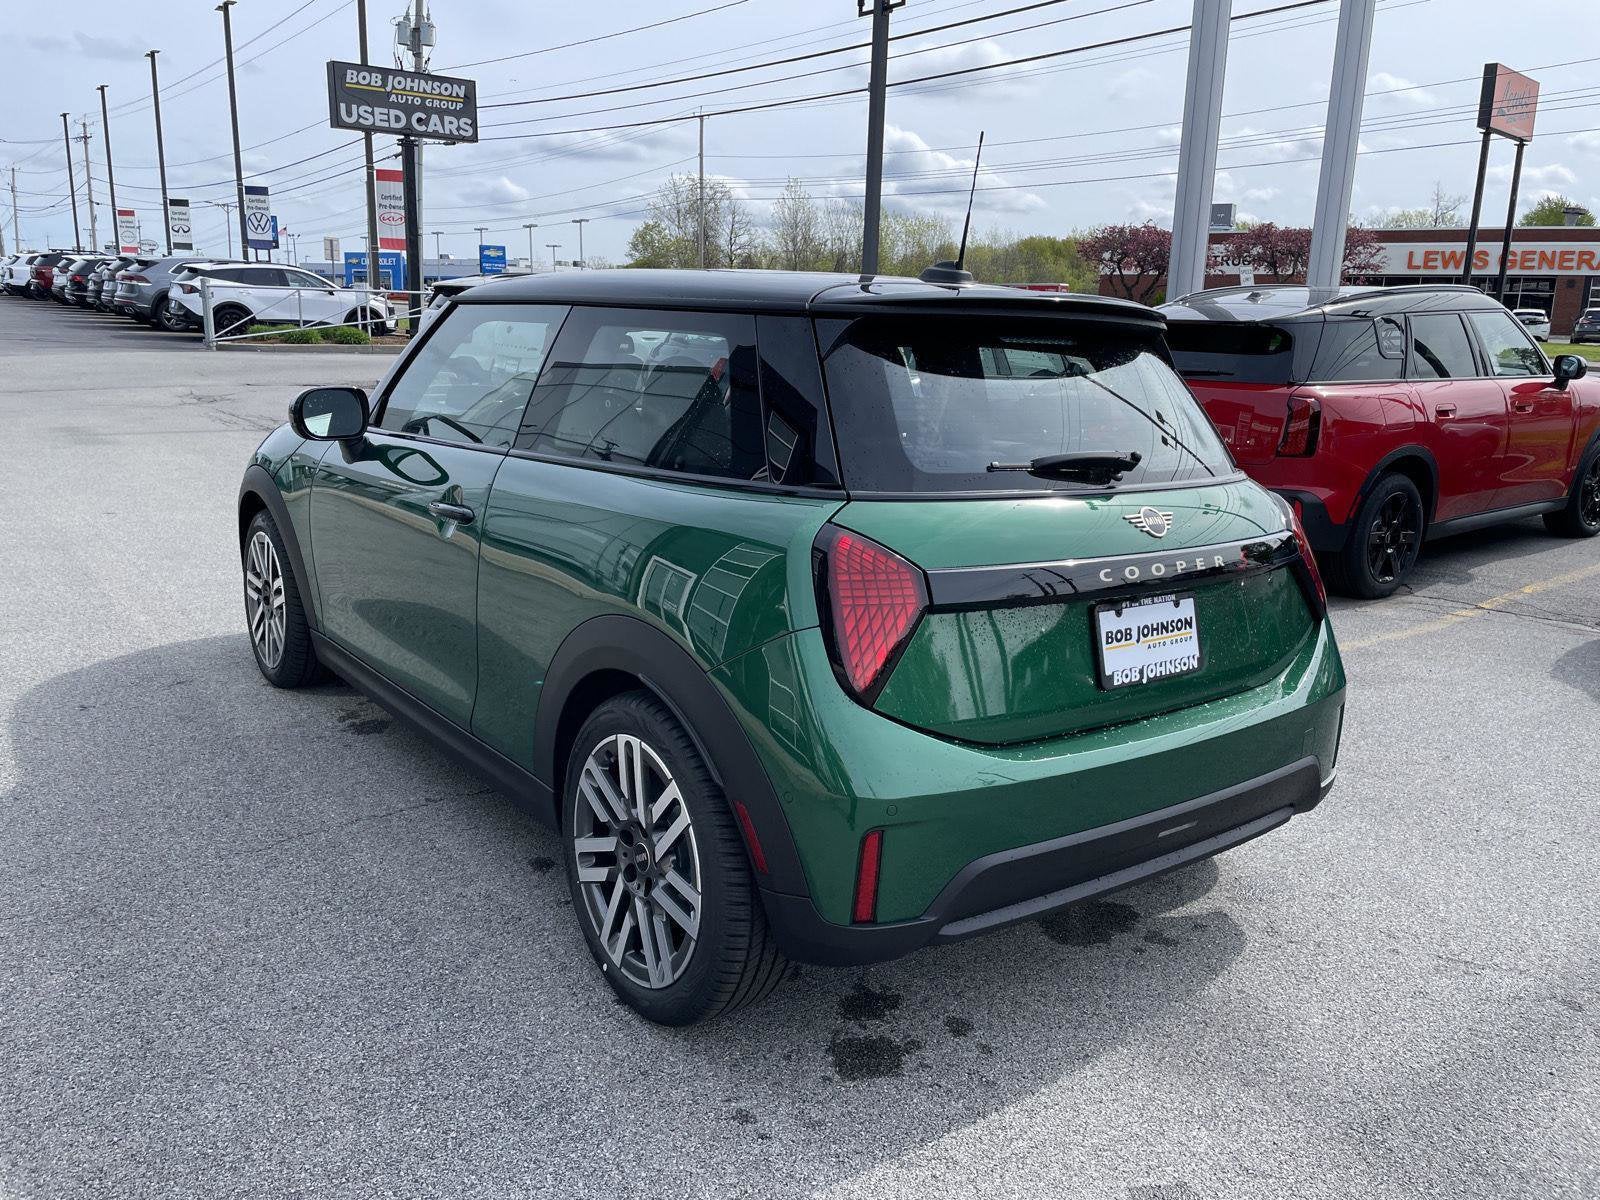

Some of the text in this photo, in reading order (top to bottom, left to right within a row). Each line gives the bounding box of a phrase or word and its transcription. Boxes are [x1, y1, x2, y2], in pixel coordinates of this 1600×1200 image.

[345, 69, 465, 98] BOB JOHNSON
[389, 94, 464, 111] AUTO GROUP
[339, 102, 474, 137] USED CARS
[381, 193, 403, 201] Certified
[1407, 250, 1489, 270] LEWS
[1145, 516, 1164, 526] MINI
[1099, 555, 1225, 582] COOPER
[1153, 593, 1176, 604] NATION
[1105, 616, 1193, 645] BOB JOHNSON
[1147, 635, 1193, 650] AUTO GROUP
[1113, 654, 1199, 686] BOB JOHNSON
